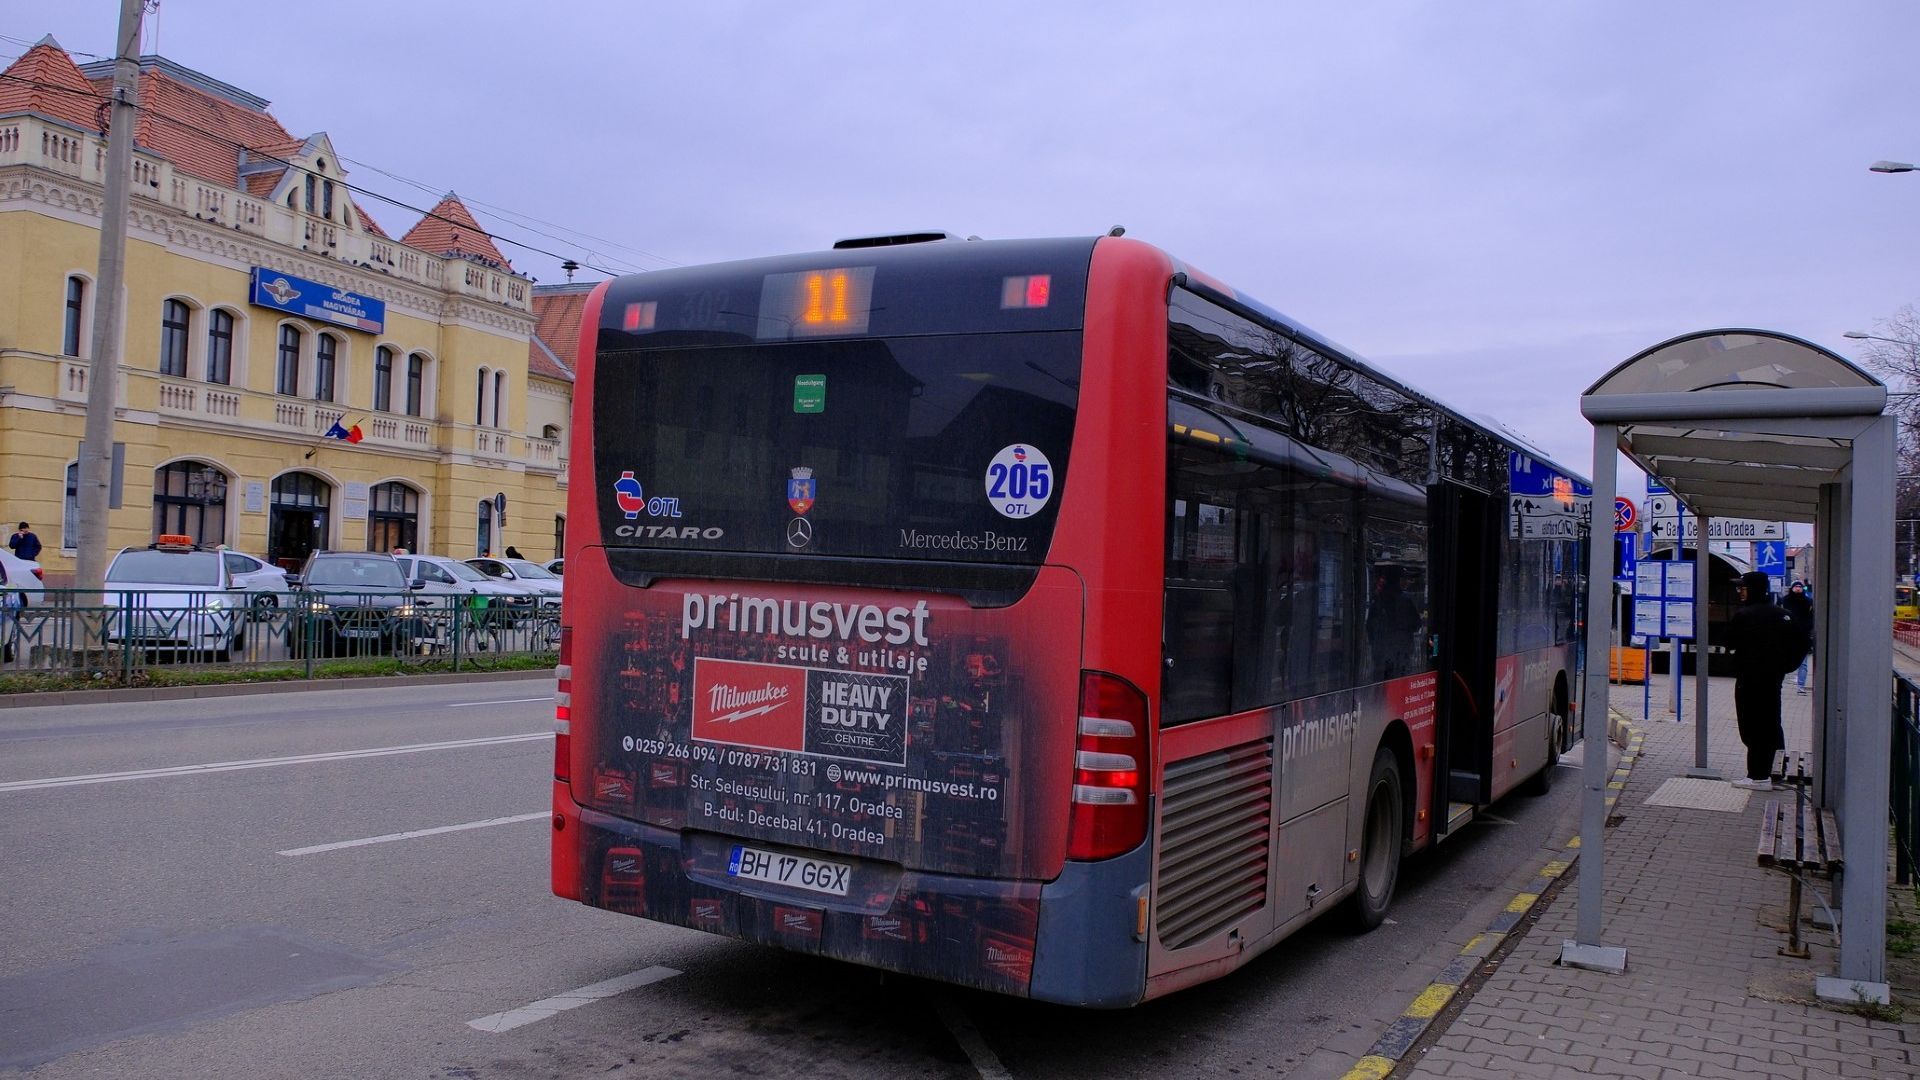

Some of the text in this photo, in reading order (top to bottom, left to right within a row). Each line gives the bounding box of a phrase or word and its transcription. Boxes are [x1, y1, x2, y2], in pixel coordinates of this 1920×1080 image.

[808, 275, 848, 321] 11
[989, 463, 1049, 500] 205
[648, 496, 682, 518] OTL
[1005, 503, 1030, 515] OTL
[615, 524, 724, 539] CITARO
[900, 528, 1027, 551] Mercedes-Benz
[1724, 520, 1755, 537] Oradea
[681, 591, 929, 647] primusvest
[777, 645, 928, 674] scule & utilaje
[708, 682, 788, 713] Milwaukee
[821, 680, 892, 710] HEAVY
[821, 706, 891, 731] DUTY
[834, 733, 875, 746] CENTRE
[635, 738, 816, 777] 0259 266 094 / 0787 731 831
[690, 774, 711, 790] Str.
[793, 792, 811, 806] nr.
[817, 792, 845, 814] 117,
[849, 797, 903, 820] Oradea
[843, 768, 997, 801] www.primusvest.ro
[704, 802, 885, 845] B-dul: Decebal 41, Oradea
[740, 851, 848, 891] BH 17 GGX
